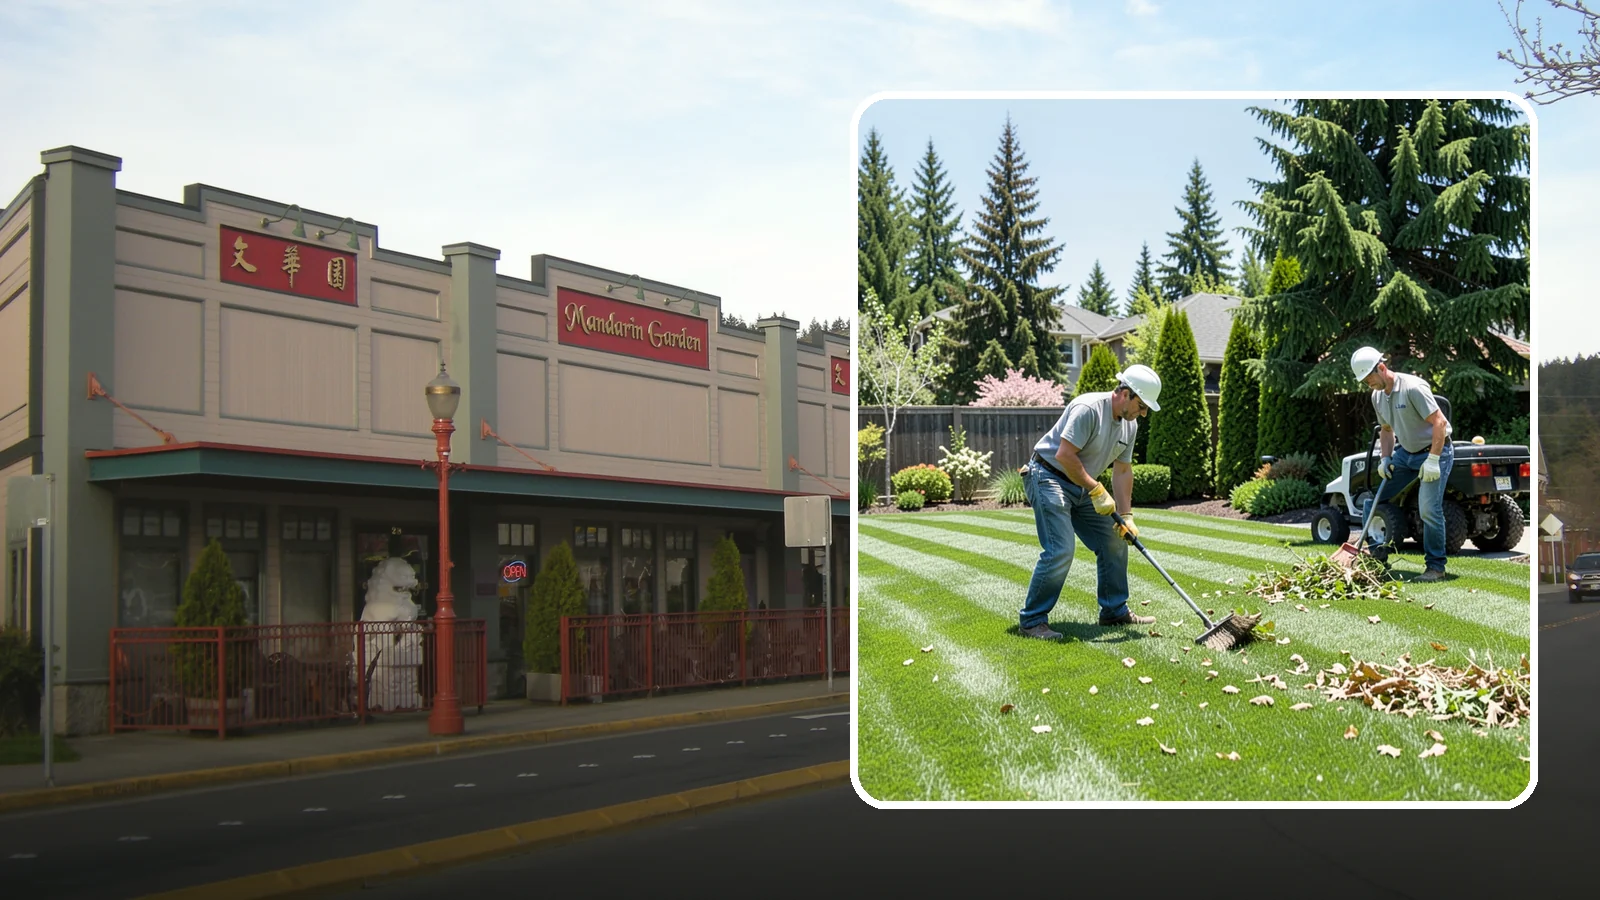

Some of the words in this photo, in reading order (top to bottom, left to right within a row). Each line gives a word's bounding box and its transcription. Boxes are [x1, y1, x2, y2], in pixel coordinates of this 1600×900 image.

[231, 236, 346, 290] 文華園
[565, 303, 643, 341] Mandarin
[648, 321, 701, 352] Garden
[503, 565, 527, 578] OPEN
